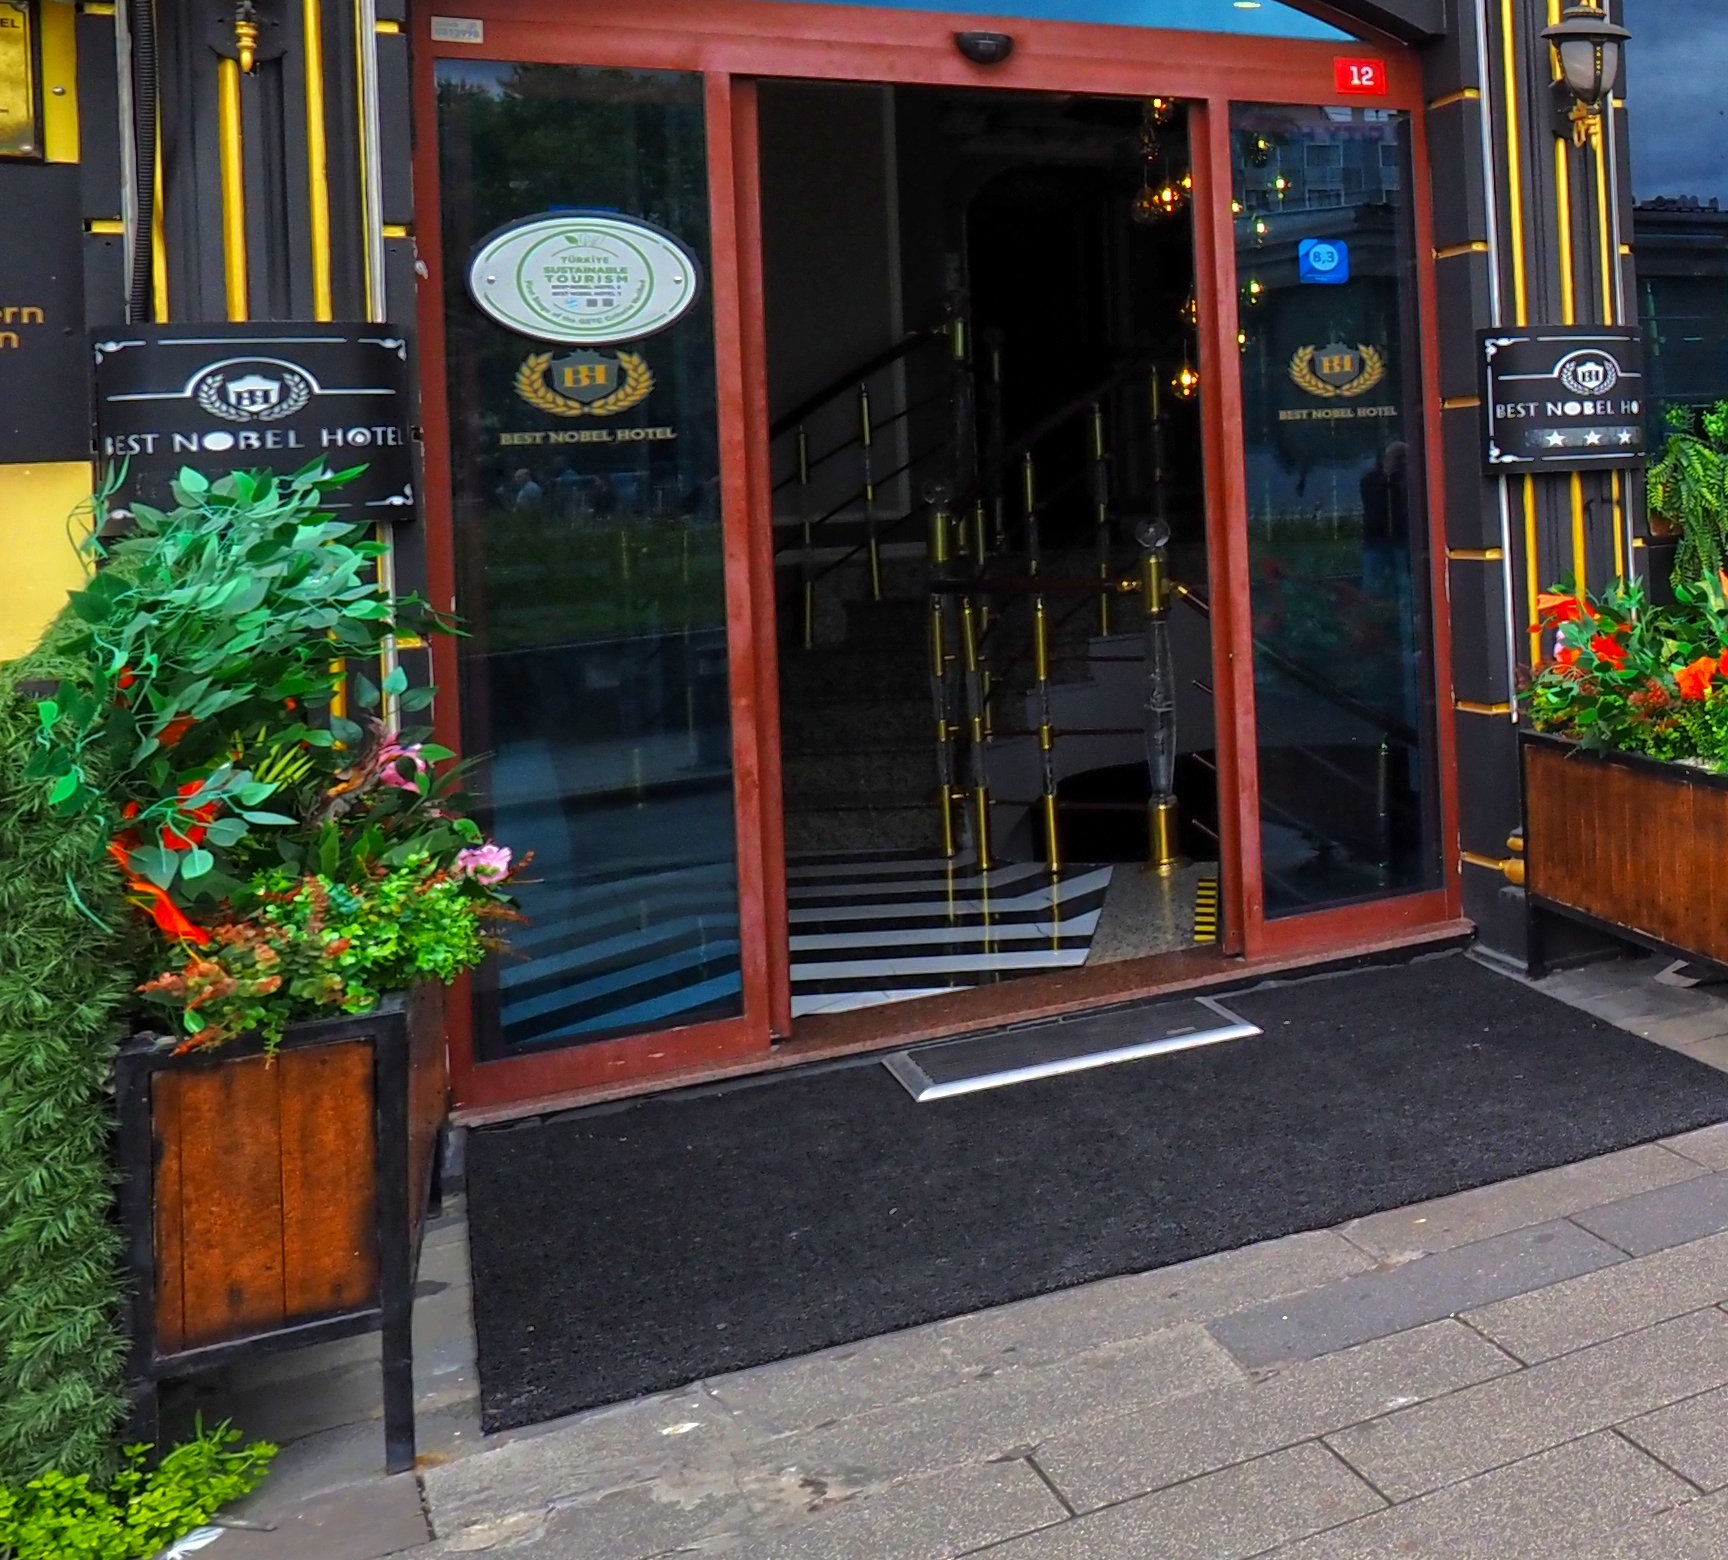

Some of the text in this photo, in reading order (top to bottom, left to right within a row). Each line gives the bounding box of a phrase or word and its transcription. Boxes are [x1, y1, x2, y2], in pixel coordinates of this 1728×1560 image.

[1349, 65, 1375, 87] 12
[543, 274, 629, 284] TOURISM
[1278, 408, 1308, 420] BEST
[1311, 407, 1355, 419] NOBEL
[1496, 402, 1540, 419] BEST
[1546, 400, 1615, 416] NOBEL
[105, 432, 160, 456] BEST
[172, 428, 306, 453] NOBEL
[500, 426, 678, 445] BEST NOBEL HOTEL
